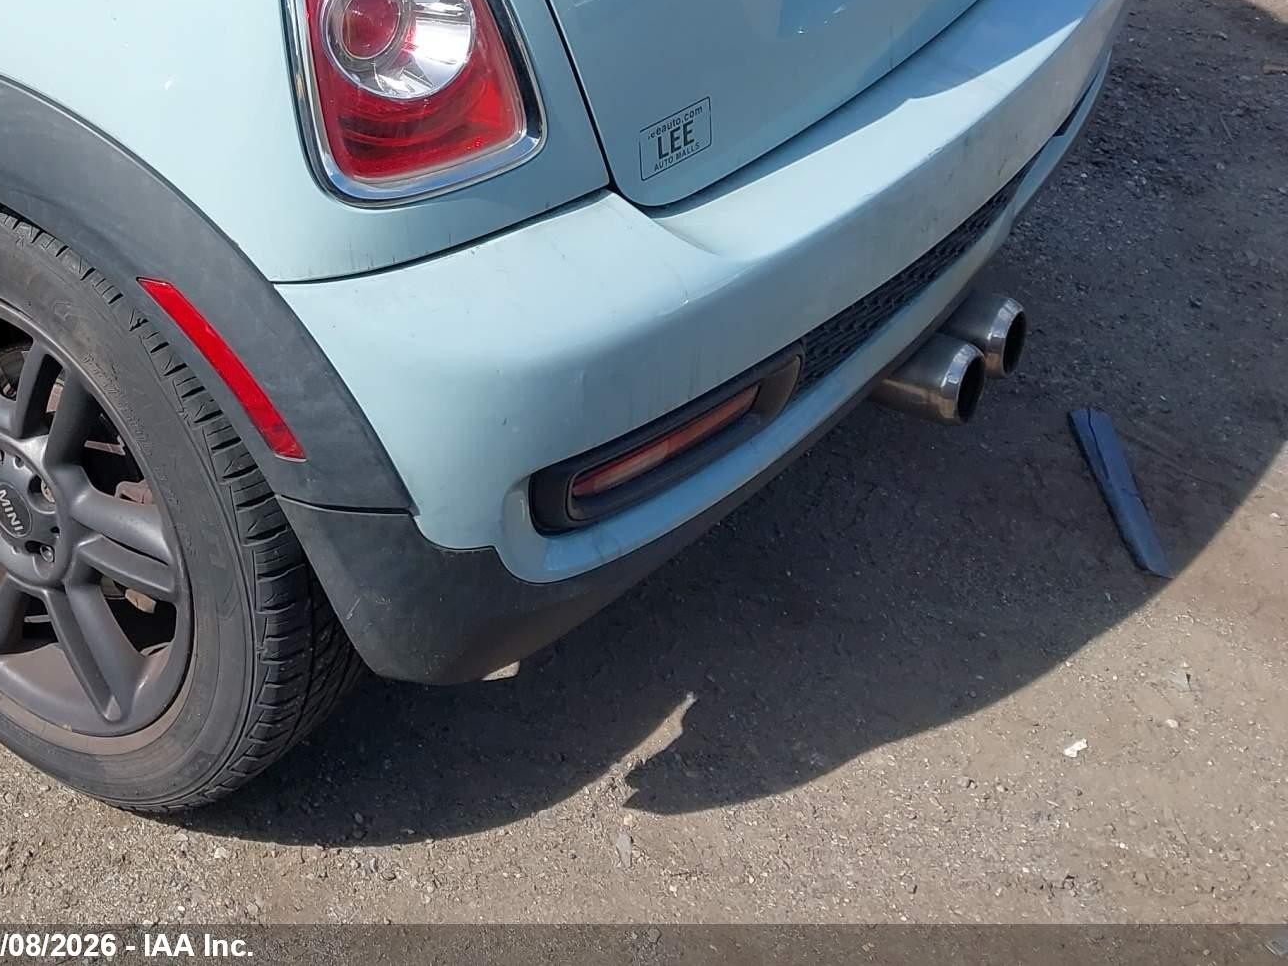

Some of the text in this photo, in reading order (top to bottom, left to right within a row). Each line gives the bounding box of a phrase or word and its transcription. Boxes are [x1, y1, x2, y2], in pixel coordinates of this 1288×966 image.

[657, 120, 695, 159] LEE
[654, 143, 701, 171] AUTO MALLS
